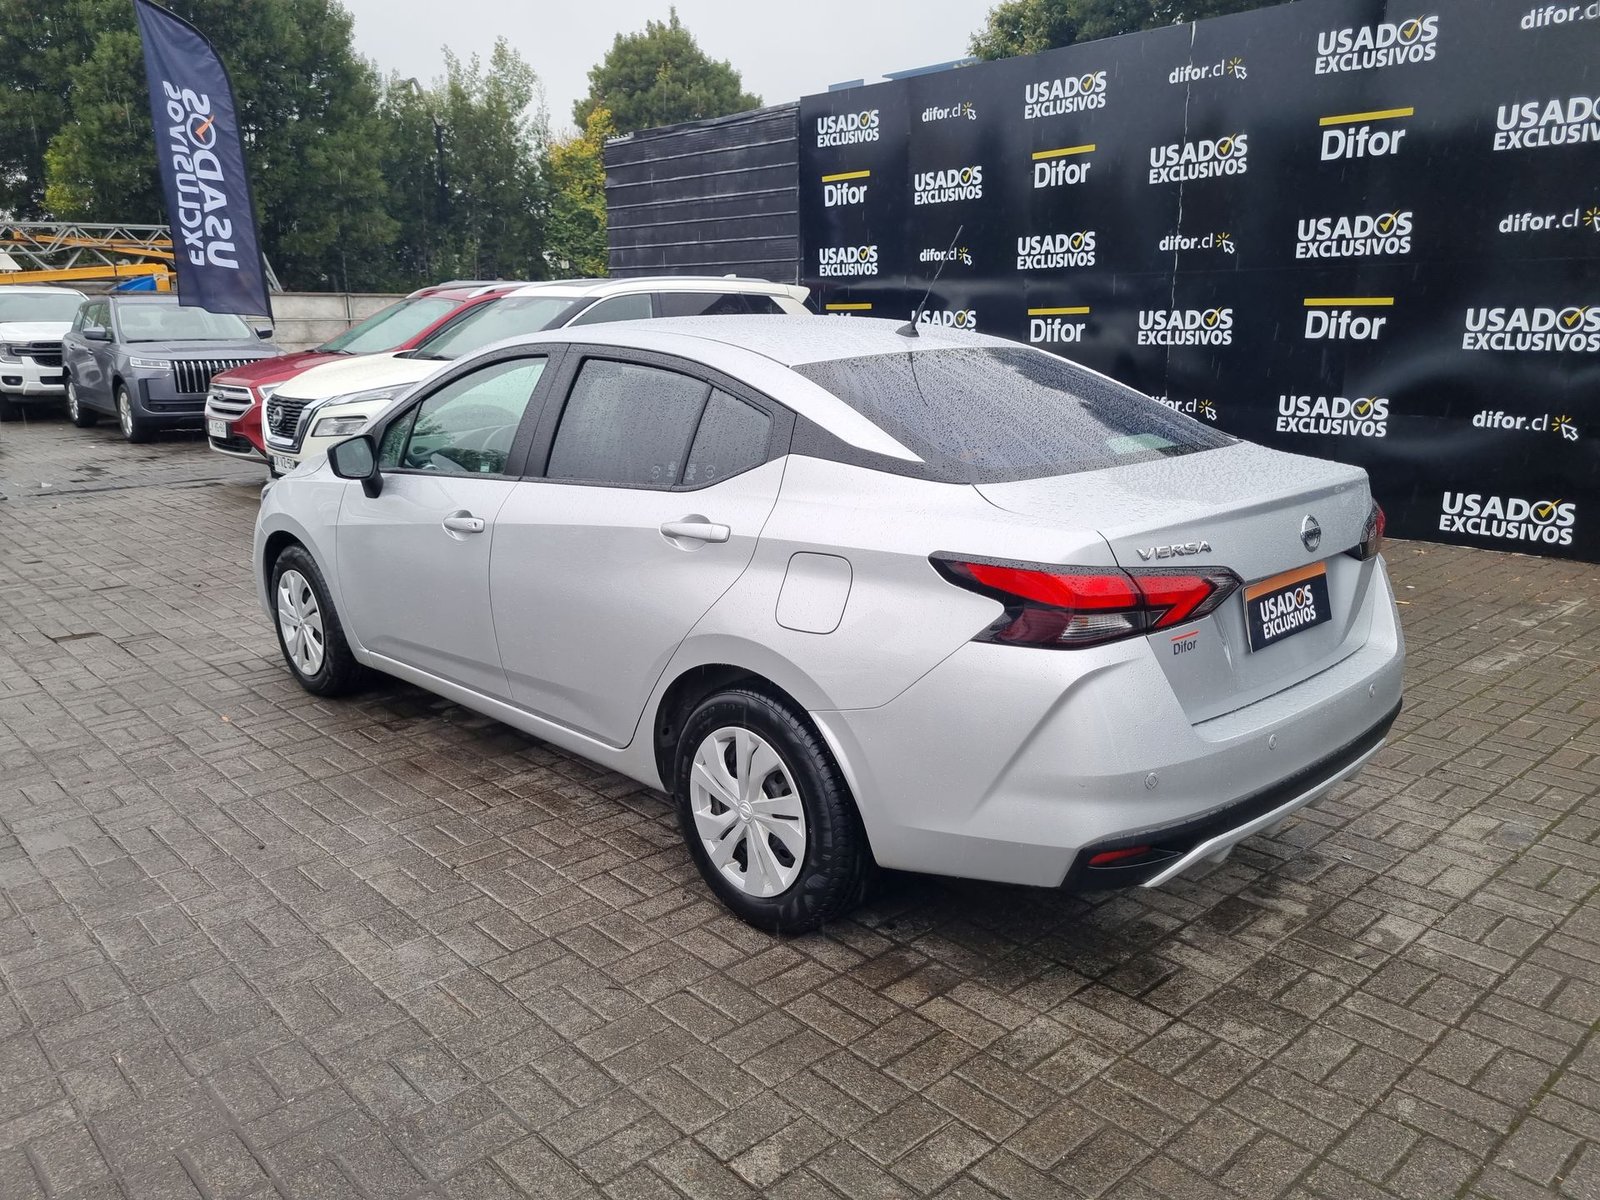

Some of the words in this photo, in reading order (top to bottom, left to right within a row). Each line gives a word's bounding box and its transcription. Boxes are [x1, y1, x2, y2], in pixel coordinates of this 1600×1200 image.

[1317, 15, 1438, 55] USADOS
[1314, 42, 1436, 74] EXCLUSIVOS
[1168, 60, 1225, 84] difor.cl
[1025, 71, 1106, 104] USADOS
[921, 103, 960, 122] difor.cl
[1024, 92, 1106, 119] EXCLUSIVOS
[1495, 97, 1600, 130] USAD
[817, 109, 880, 134] USADOS
[817, 127, 880, 147] EXCLUSIVOS
[1320, 126, 1406, 160] Difor
[1150, 134, 1248, 168] USADOS
[914, 165, 982, 191] USADOS
[1034, 160, 1091, 188] Difor
[1149, 157, 1247, 184] EXCLUSIVOS
[824, 184, 867, 207] Difor
[914, 185, 982, 205] EXCLUSIVOS
[1297, 211, 1412, 241] USADOS
[1499, 209, 1579, 233] difor.cl
[1017, 231, 1095, 255] USADOS
[1159, 233, 1213, 251] difor.cl
[1295, 236, 1411, 258] EXCLUSIVOS
[819, 245, 878, 264] USADOS
[919, 247, 957, 262] difor.cl
[1016, 251, 1095, 270] EXCLUSIVOS
[819, 263, 878, 276] EXCLUSIVOS
[1030, 318, 1085, 342] Difor
[1138, 308, 1233, 330] USADOS
[1305, 310, 1386, 340] Difor
[1465, 307, 1600, 333] USADOS
[1137, 329, 1233, 346] EXCLUSIVOS
[1462, 332, 1600, 352] EXCLUSIVOS
[1278, 395, 1389, 421] USADOS
[1276, 416, 1388, 437] EXCLUSIVOS
[1472, 410, 1548, 431] difor.cl
[1442, 491, 1576, 526] USADOS
[1439, 514, 1573, 545] EXCLUSIVOS
[1136, 540, 1212, 561] VERSA
[1259, 584, 1314, 622] USADOS
[1263, 604, 1317, 640] EXCLUSIVOS
[1173, 639, 1197, 656] Difor
